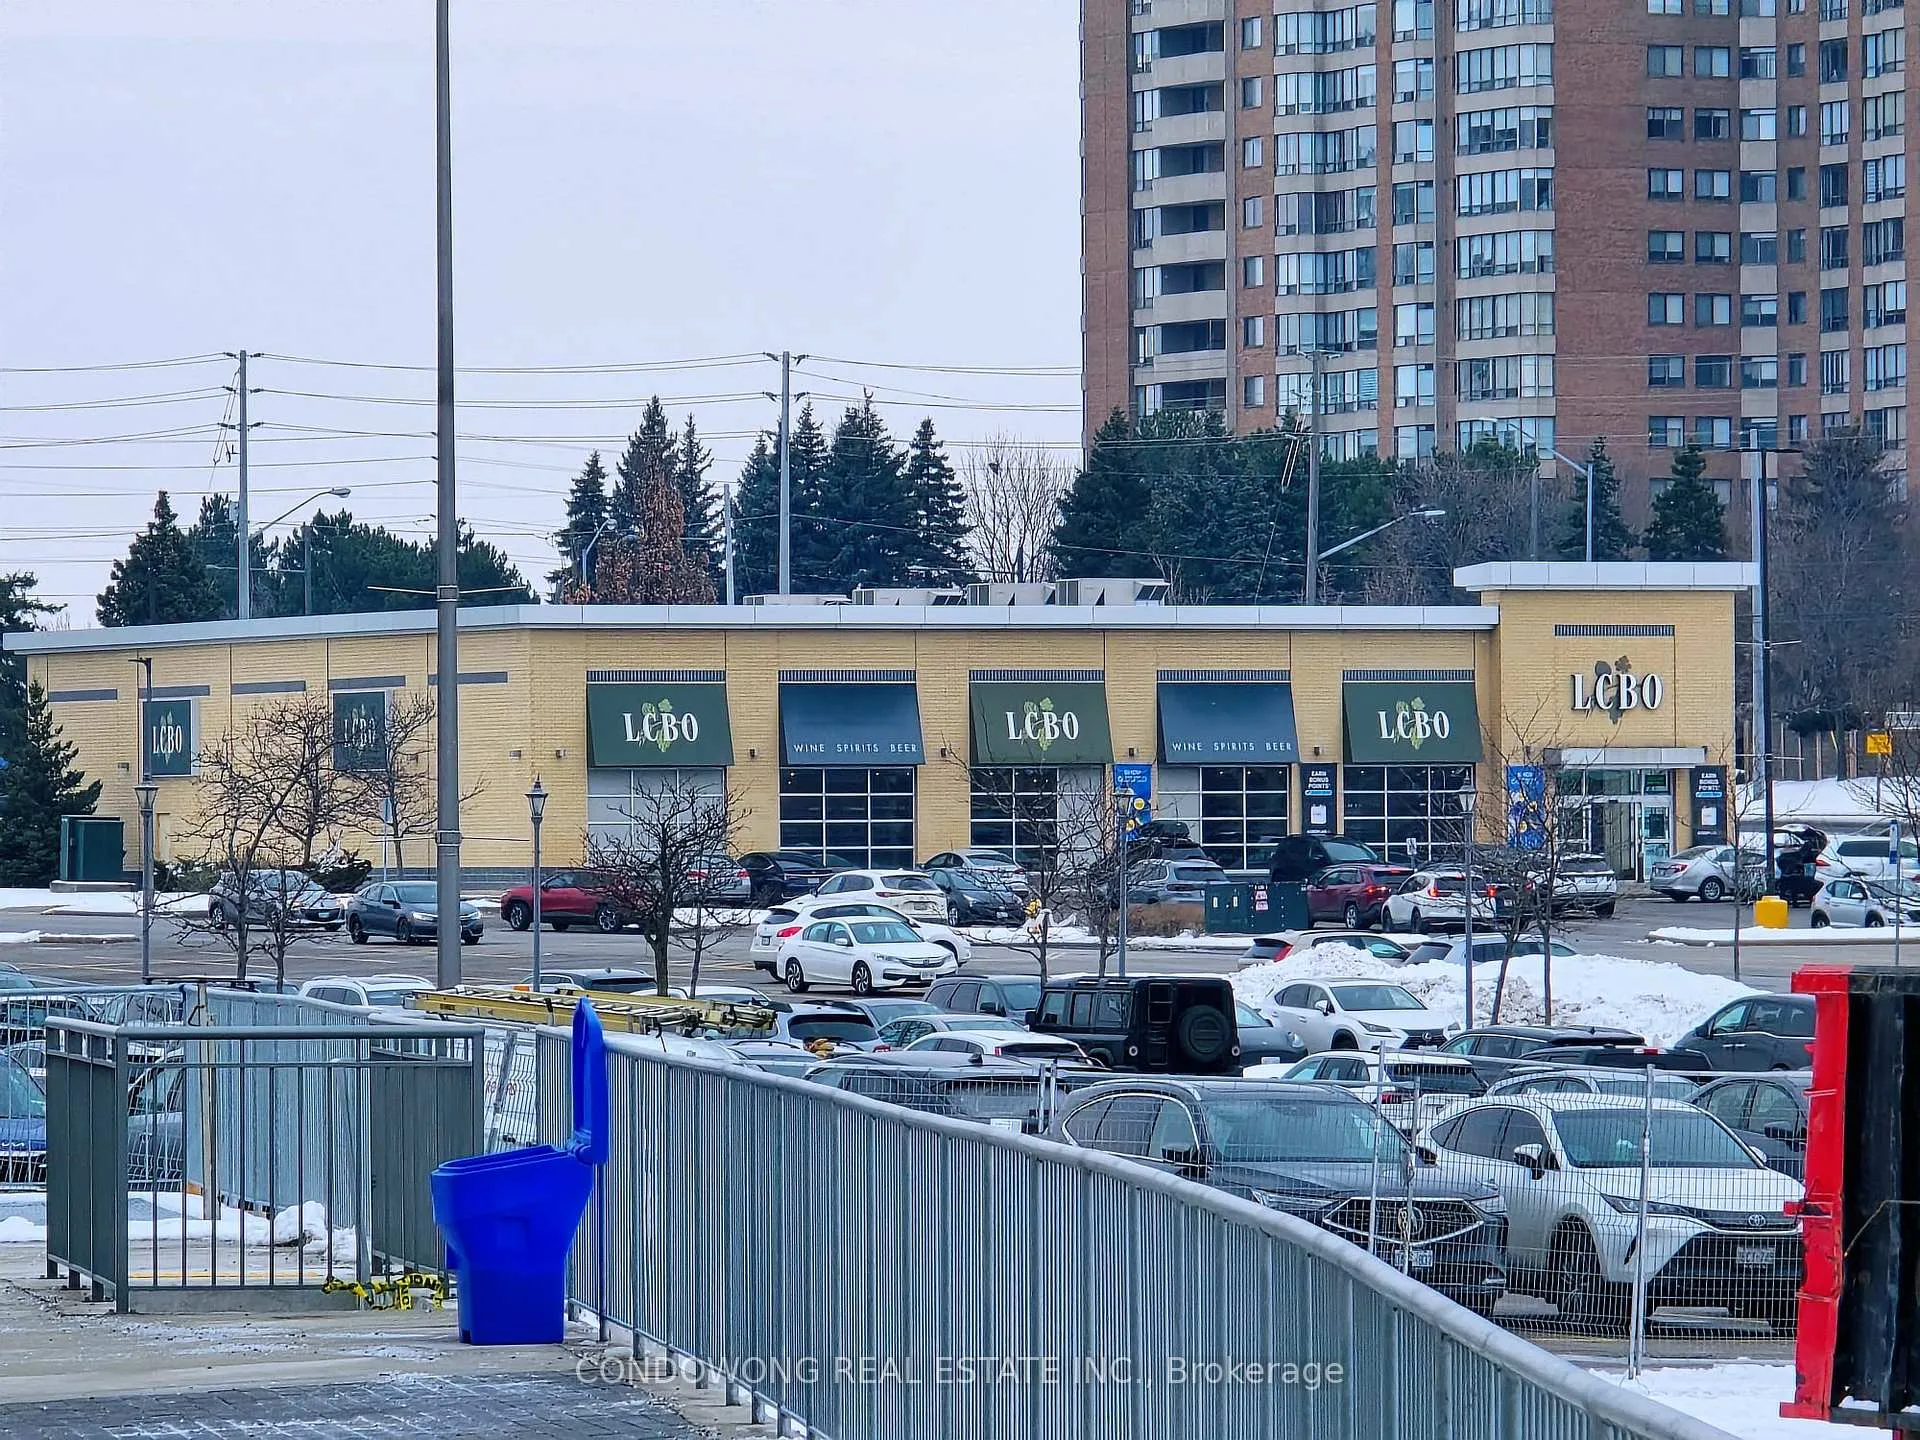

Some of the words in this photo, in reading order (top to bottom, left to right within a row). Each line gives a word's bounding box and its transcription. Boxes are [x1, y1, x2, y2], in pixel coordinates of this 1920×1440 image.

[1571, 673, 1664, 711] LCBO
[152, 724, 183, 754] LCBO
[622, 712, 699, 742] LCBO
[1005, 711, 1079, 740] LCBO
[1377, 710, 1450, 739] LCBO
[793, 743, 825, 753] WINE
[836, 743, 879, 753] SPIRITS
[889, 743, 917, 753] BEER
[1172, 742, 1203, 752] WINE
[1213, 742, 1256, 752] SPIRITS
[1265, 742, 1292, 752] BEER
